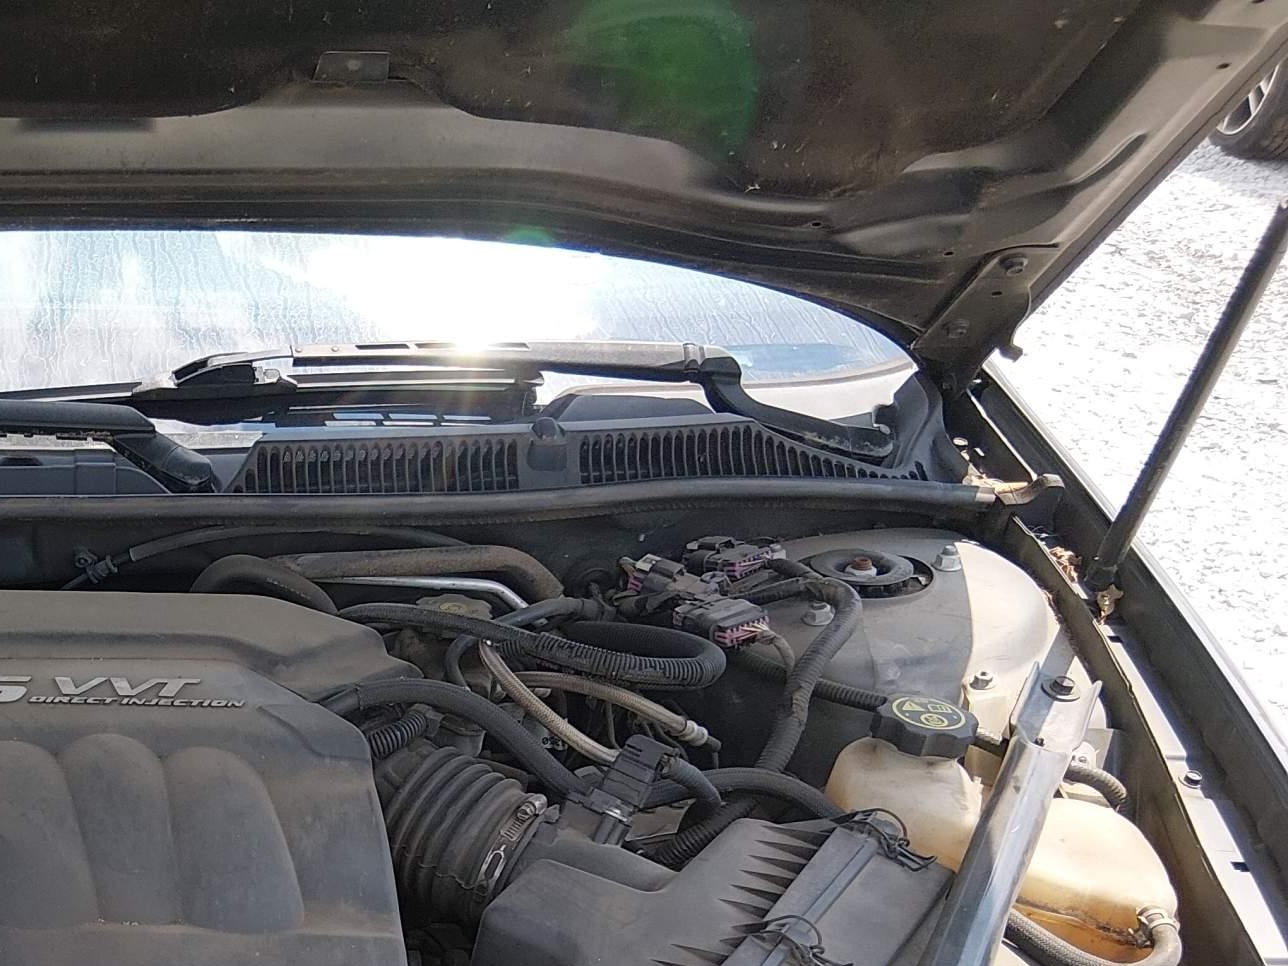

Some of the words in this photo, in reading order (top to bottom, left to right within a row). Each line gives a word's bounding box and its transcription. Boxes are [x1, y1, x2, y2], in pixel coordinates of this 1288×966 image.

[55, 676, 201, 697] VVT
[28, 696, 117, 704] DIRECT
[121, 697, 246, 707] INJECTION
